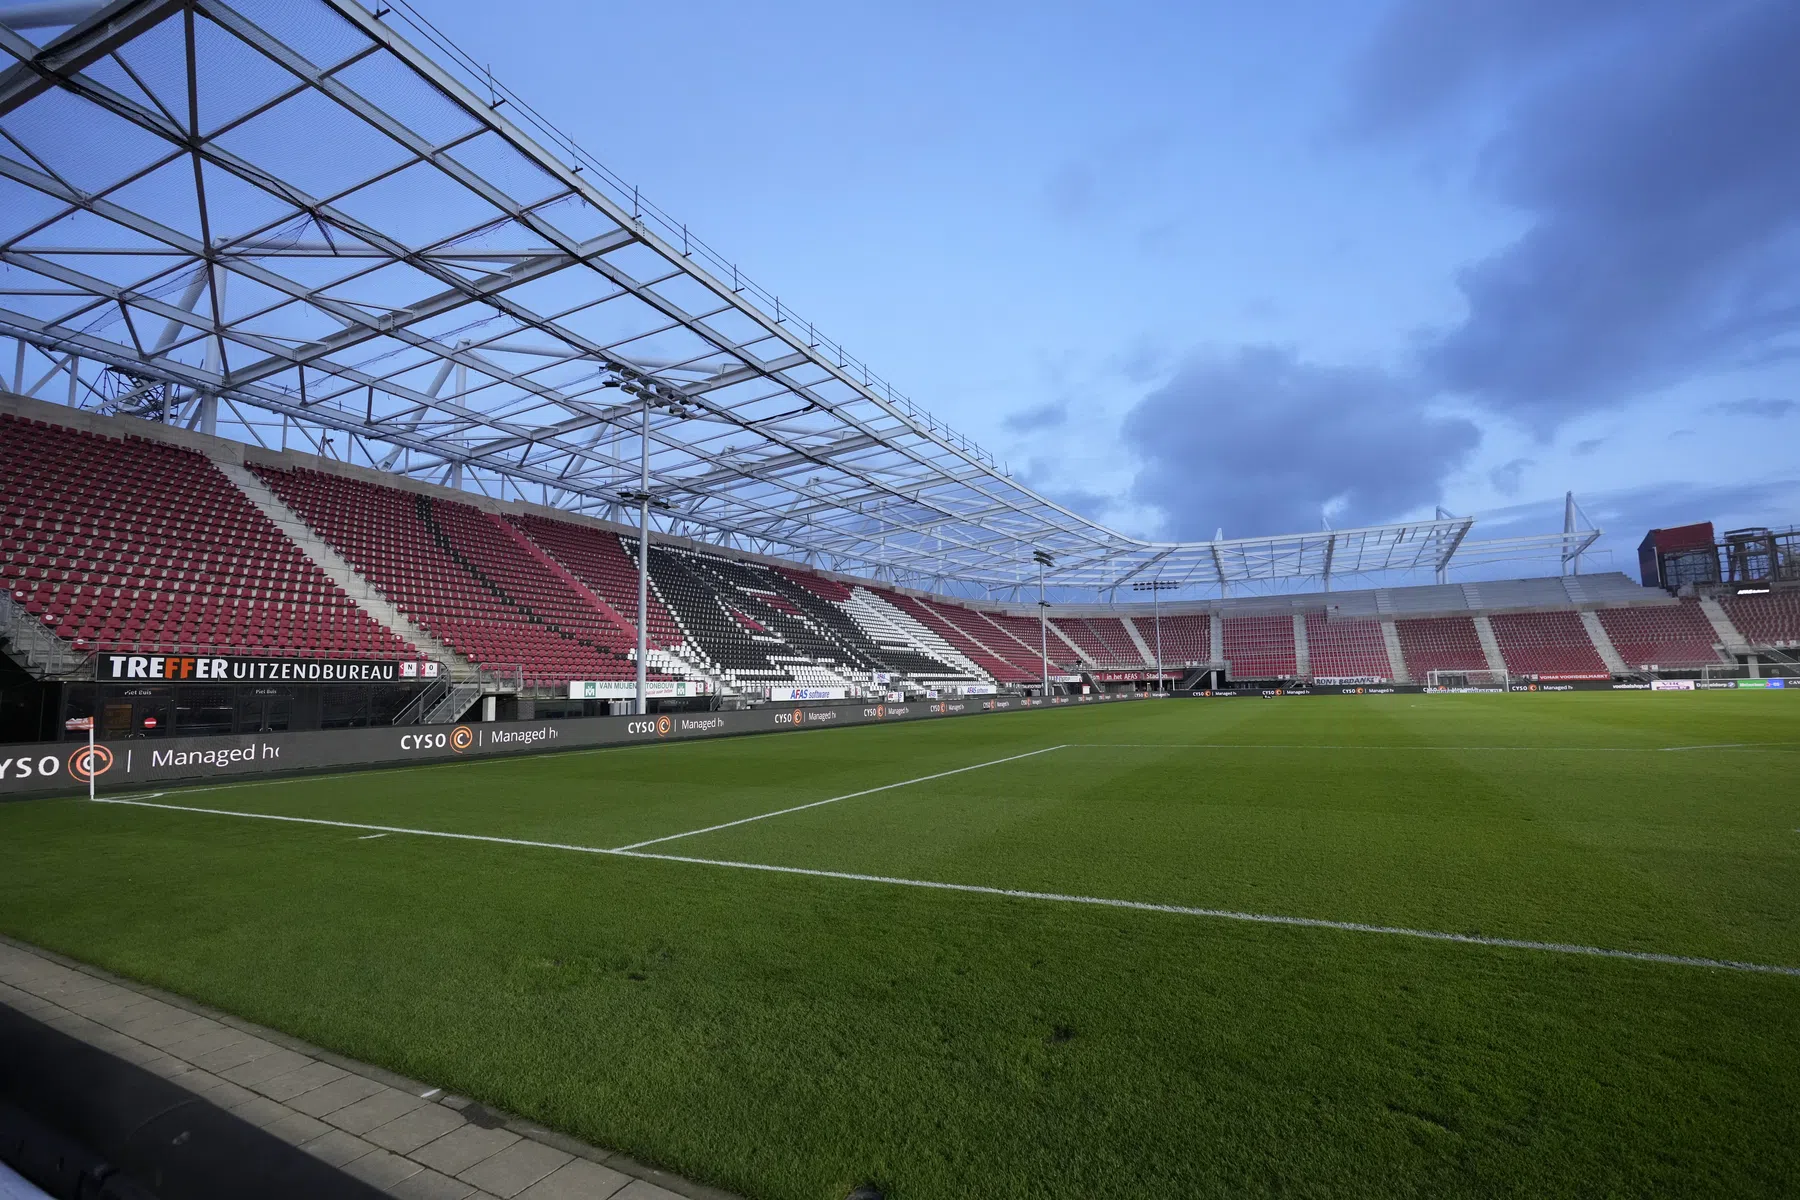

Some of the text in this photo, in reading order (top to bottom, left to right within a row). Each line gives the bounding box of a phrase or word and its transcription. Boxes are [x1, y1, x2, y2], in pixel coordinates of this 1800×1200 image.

[110, 656, 393, 680] TREFFER UITZENDBUREAU
[1113, 672, 1122, 680] het
[1124, 672, 1138, 680] AFAS
[790, 689, 830, 699] AFAS software
[774, 713, 792, 723] CYSO
[808, 711, 832, 721] Managed
[863, 708, 877, 717] CYSO
[888, 707, 906, 716] Managed
[628, 721, 655, 734] CYSO
[681, 718, 716, 731] Managed
[717, 717, 724, 727] h
[401, 733, 447, 750] CYSO
[491, 727, 546, 744] Managed
[549, 727, 559, 739] h
[0, 756, 60, 779] YSO
[152, 743, 256, 767] Managed
